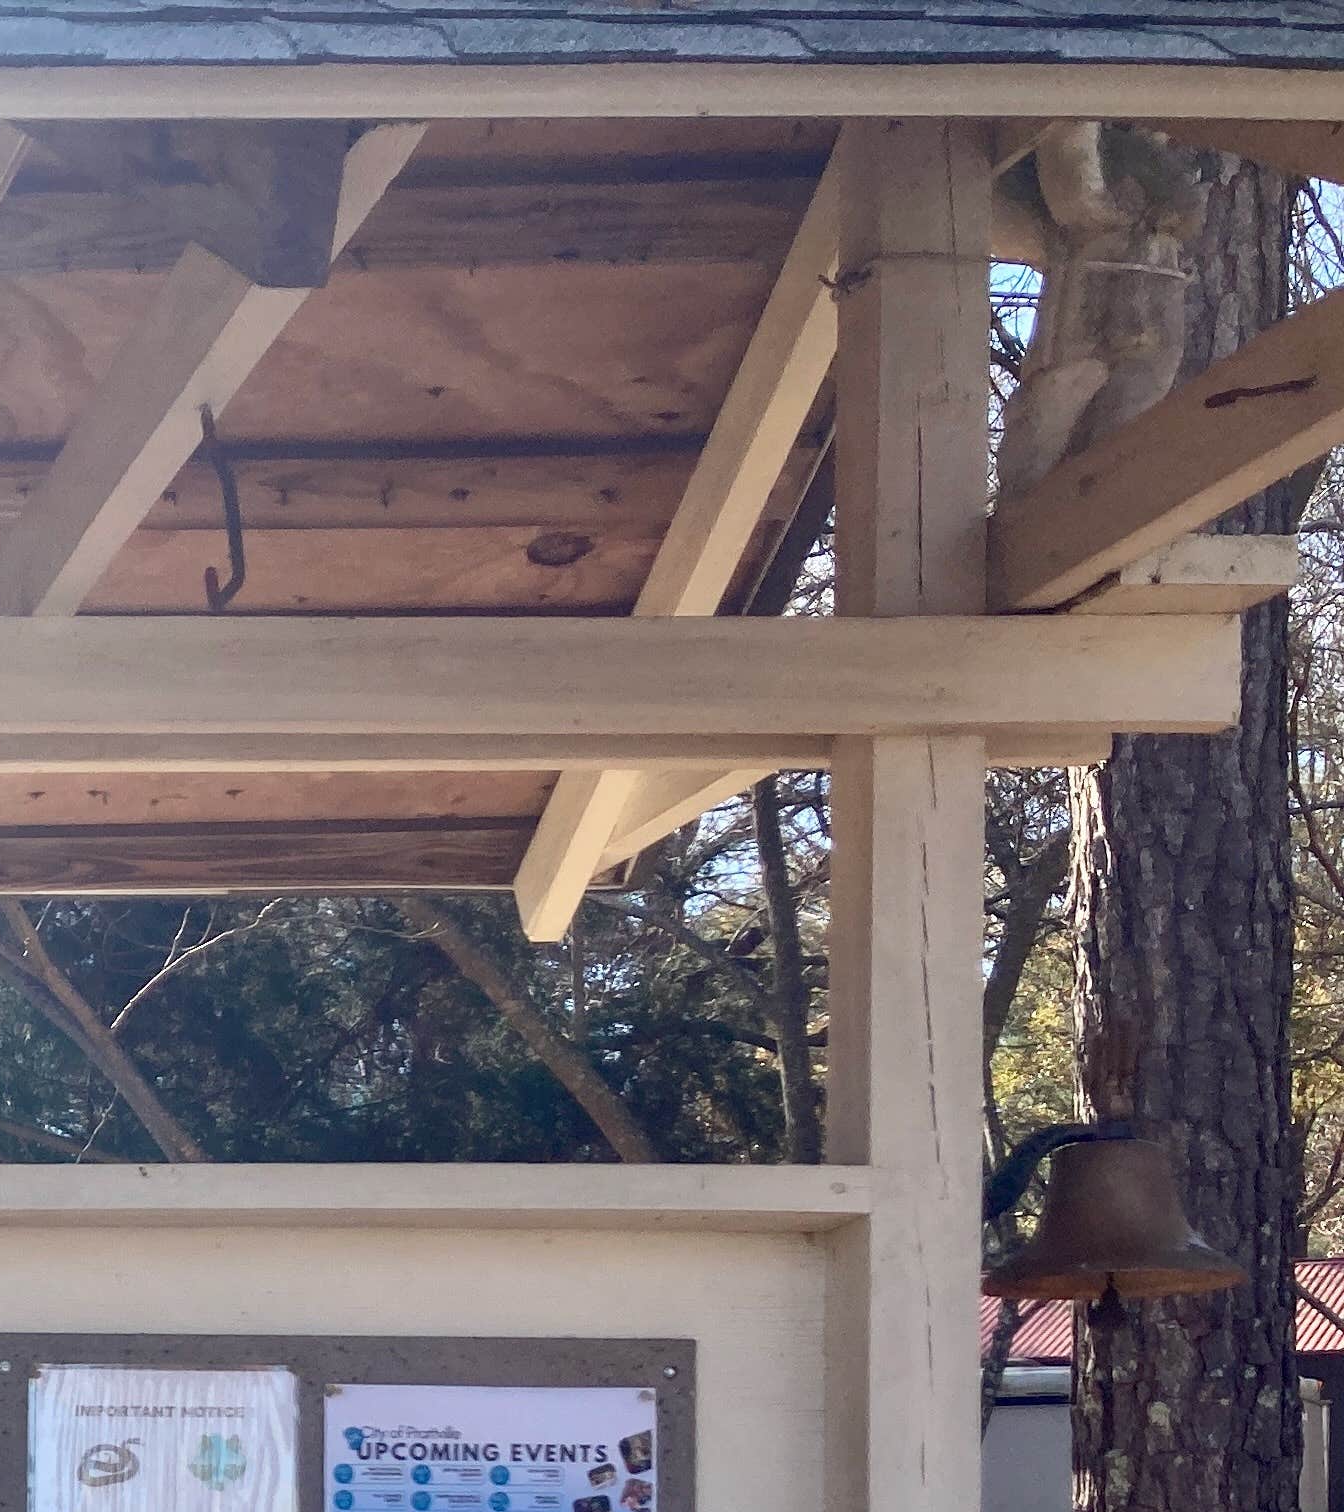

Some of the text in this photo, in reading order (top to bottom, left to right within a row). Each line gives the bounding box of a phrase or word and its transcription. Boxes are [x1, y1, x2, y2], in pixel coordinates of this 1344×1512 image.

[75, 1405, 245, 1418] IMPORTANT NOTICE
[362, 1426, 384, 1440] City
[358, 1442, 608, 1463] UPCOMING EVENTS
